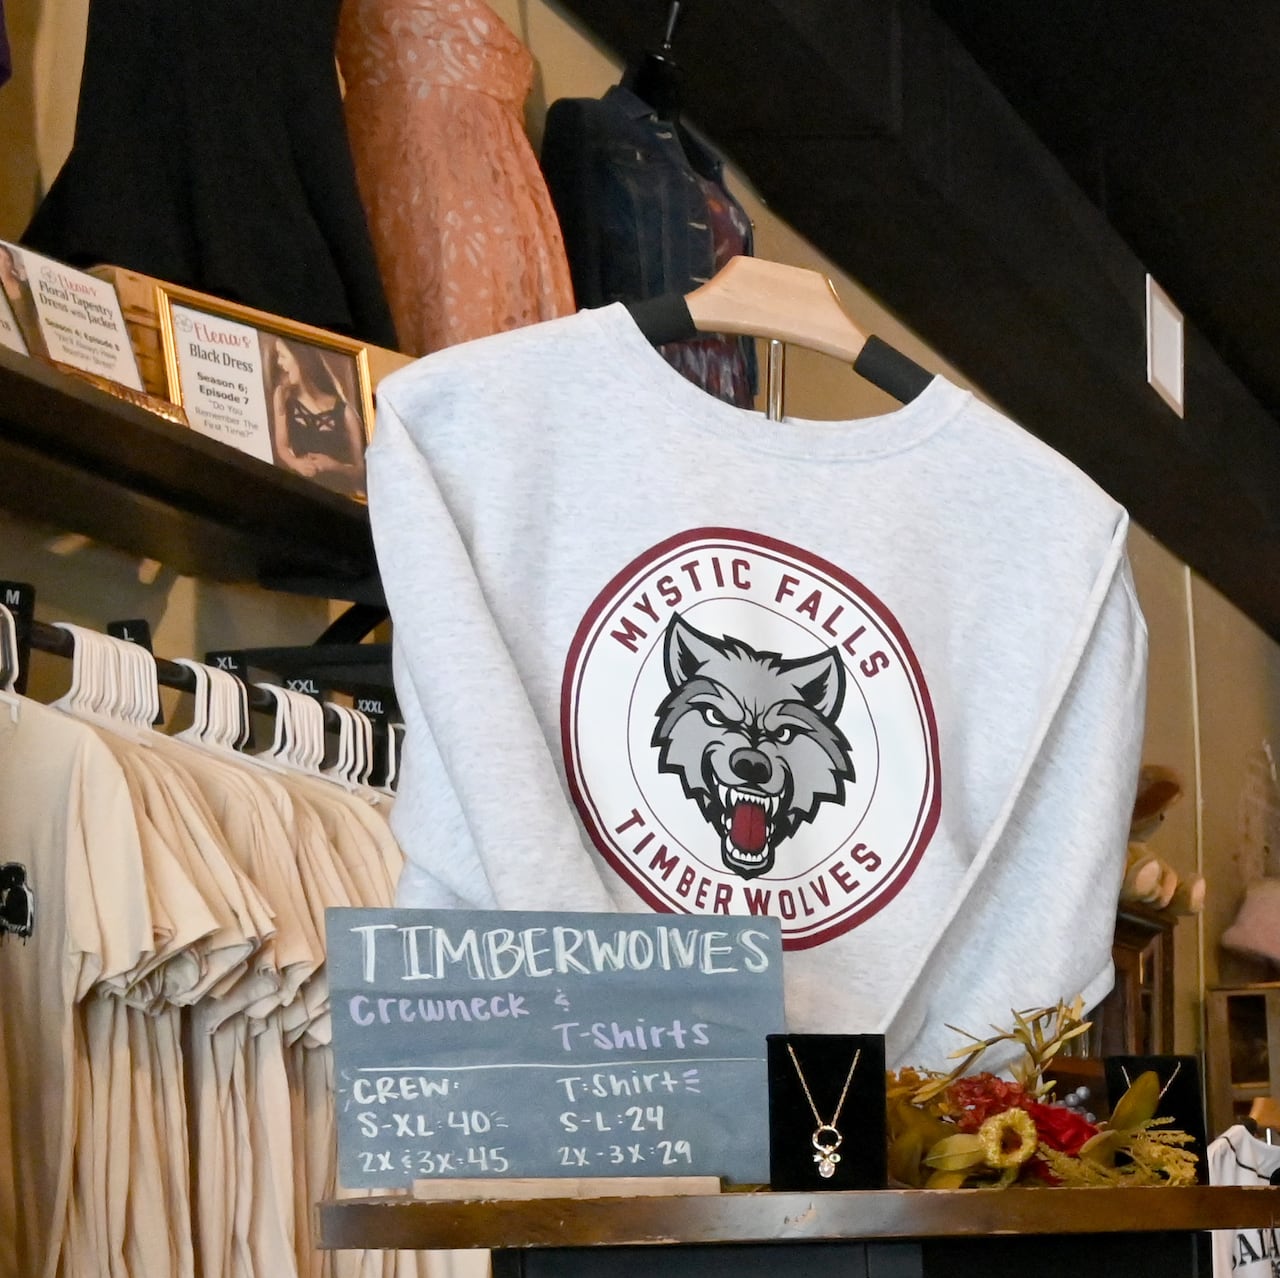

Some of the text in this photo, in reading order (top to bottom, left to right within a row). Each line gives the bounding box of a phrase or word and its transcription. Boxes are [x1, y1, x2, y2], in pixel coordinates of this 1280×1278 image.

[189, 343, 254, 373] Black Dress
[197, 371, 235, 389] Season
[199, 385, 249, 405] Episode 7
[5, 589, 20, 605] M
[610, 557, 891, 678] MYSTIC FALLS
[123, 627, 135, 641] L
[216, 656, 238, 670] XL
[286, 680, 319, 694] XXL
[358, 699, 384, 714] XXXL
[615, 808, 882, 921] TIMBERWOLVES
